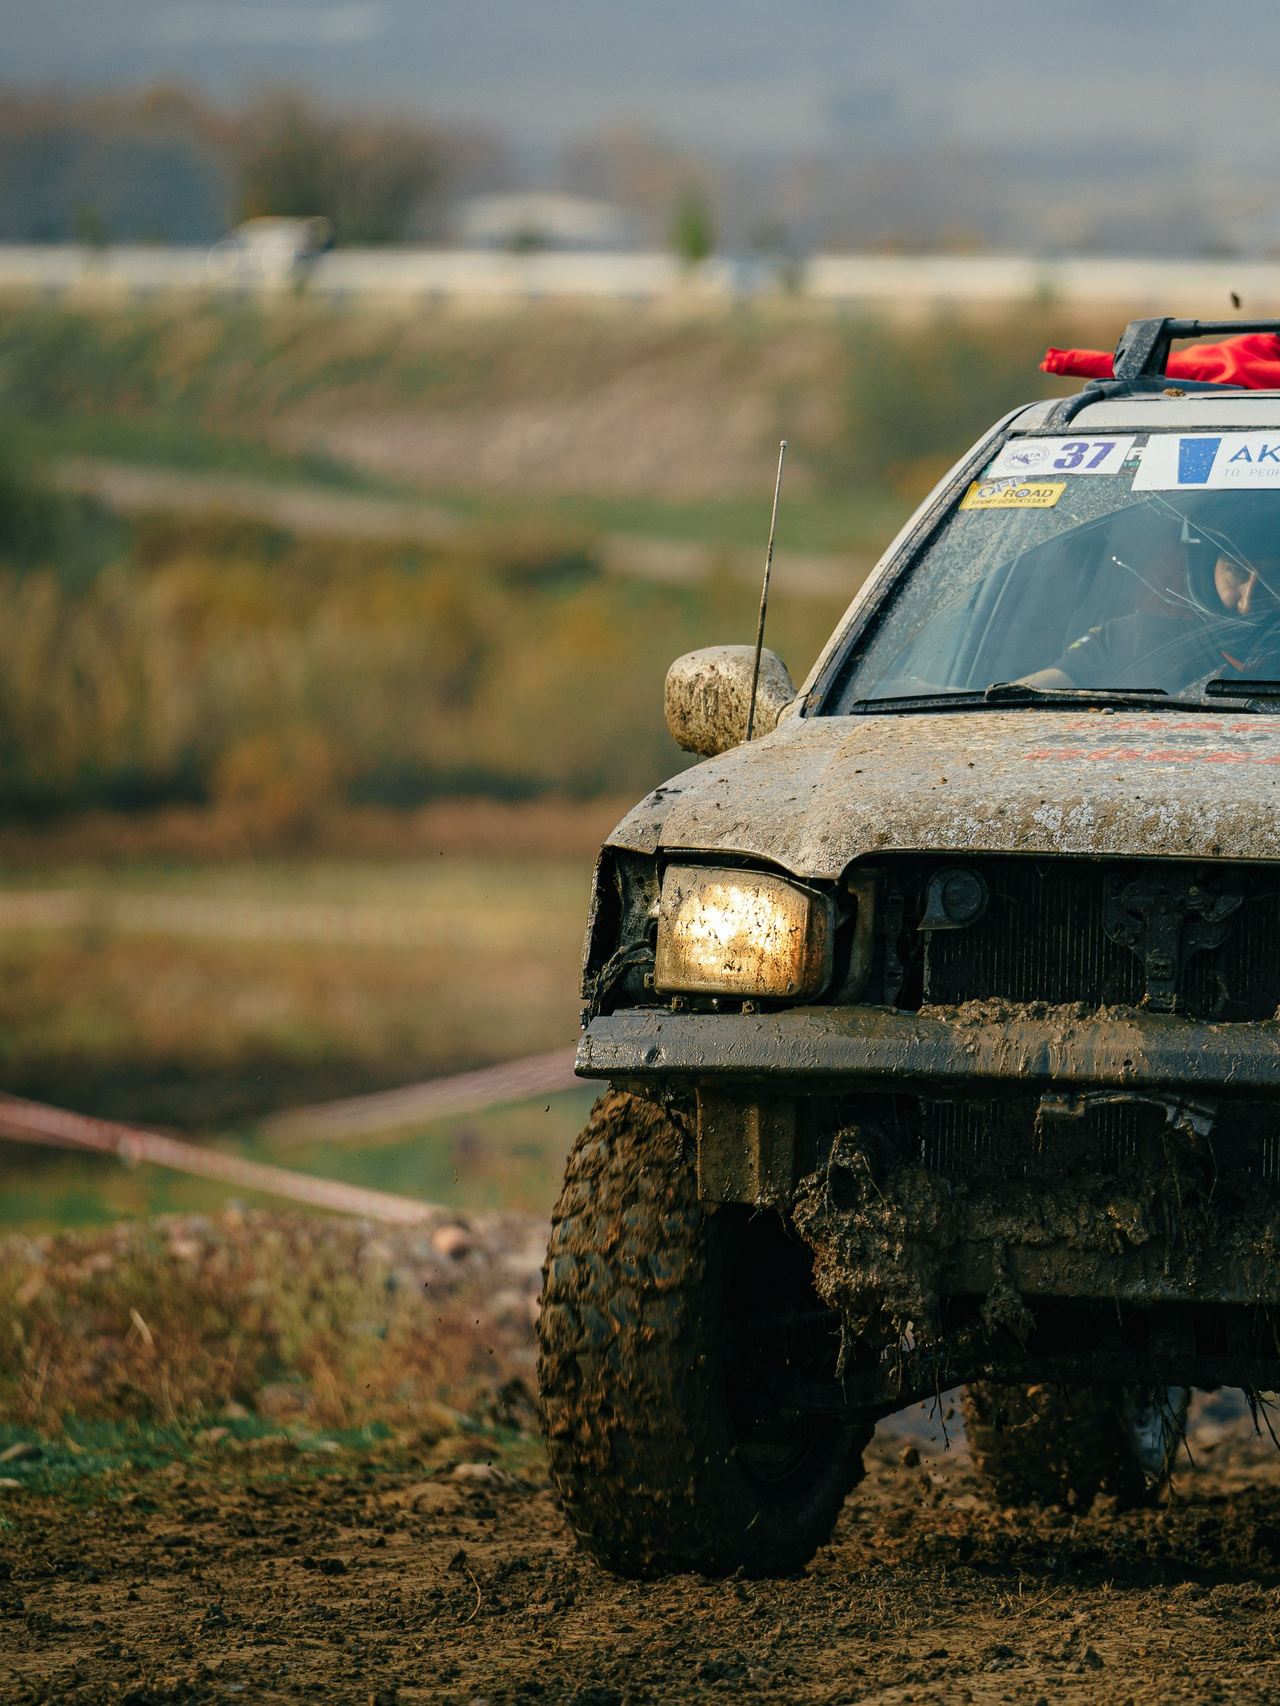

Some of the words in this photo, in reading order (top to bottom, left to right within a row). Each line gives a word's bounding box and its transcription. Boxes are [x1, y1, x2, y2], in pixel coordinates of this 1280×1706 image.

[1053, 442, 1117, 469] 37
[1224, 468, 1240, 477] TO
[976, 475, 1027, 498] OFF
[1003, 488, 1054, 499] ROAD
